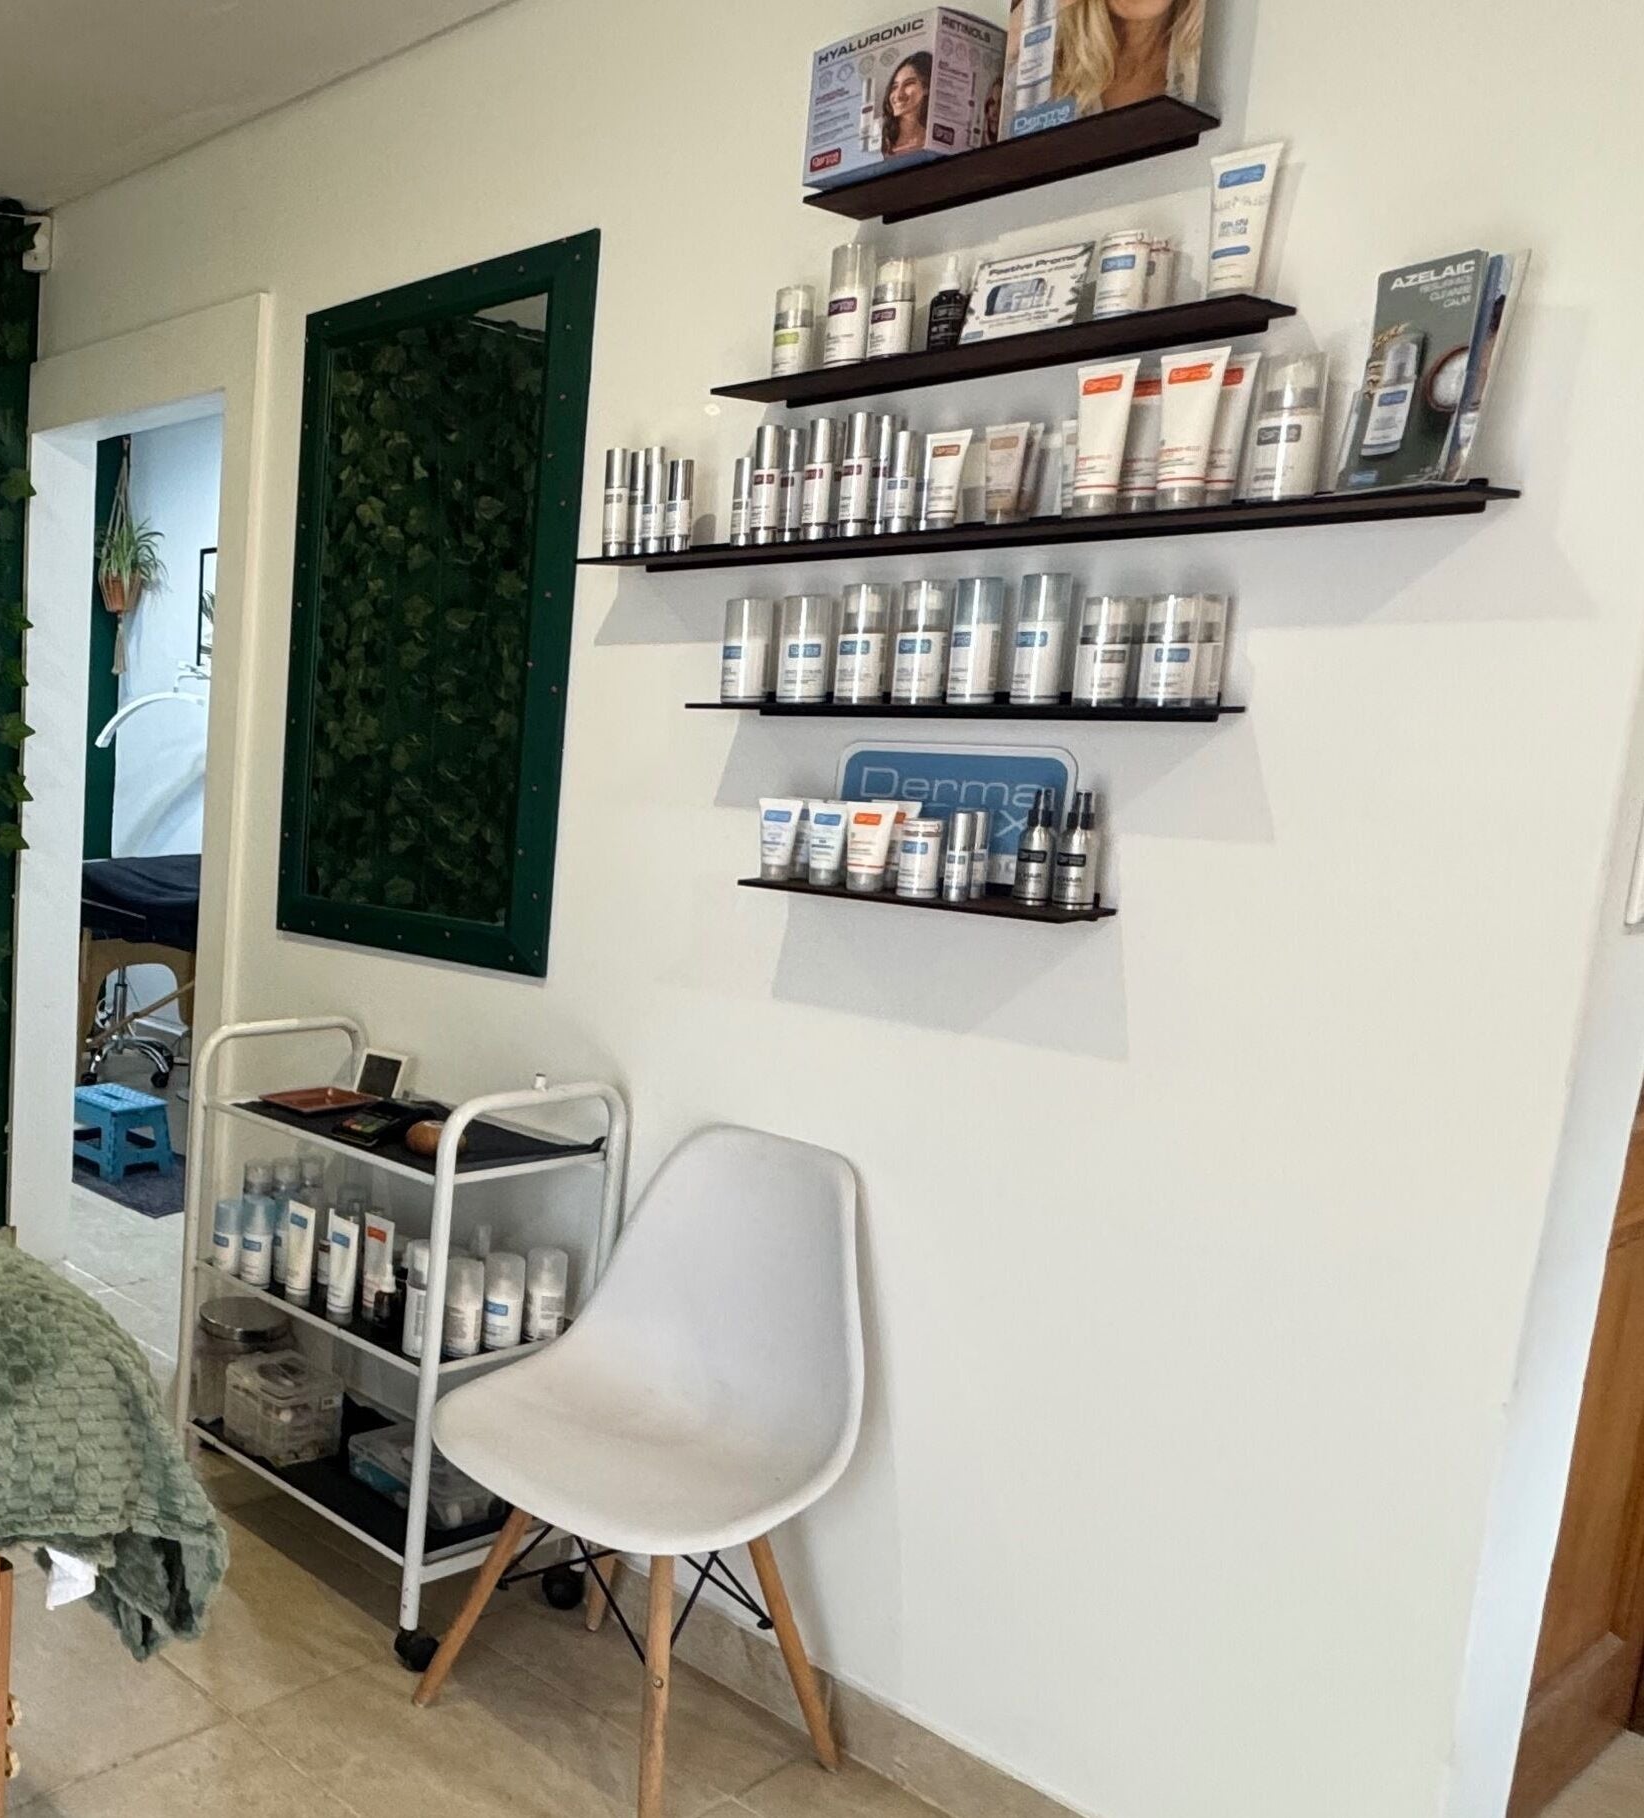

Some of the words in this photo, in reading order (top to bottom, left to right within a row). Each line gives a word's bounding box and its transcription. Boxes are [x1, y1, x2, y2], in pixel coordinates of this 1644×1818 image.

[818, 18, 924, 66] HYALURONIC
[1390, 260, 1475, 291] AZELAIC
[1443, 294, 1471, 308] CALM
[860, 766, 1044, 808] Derma
